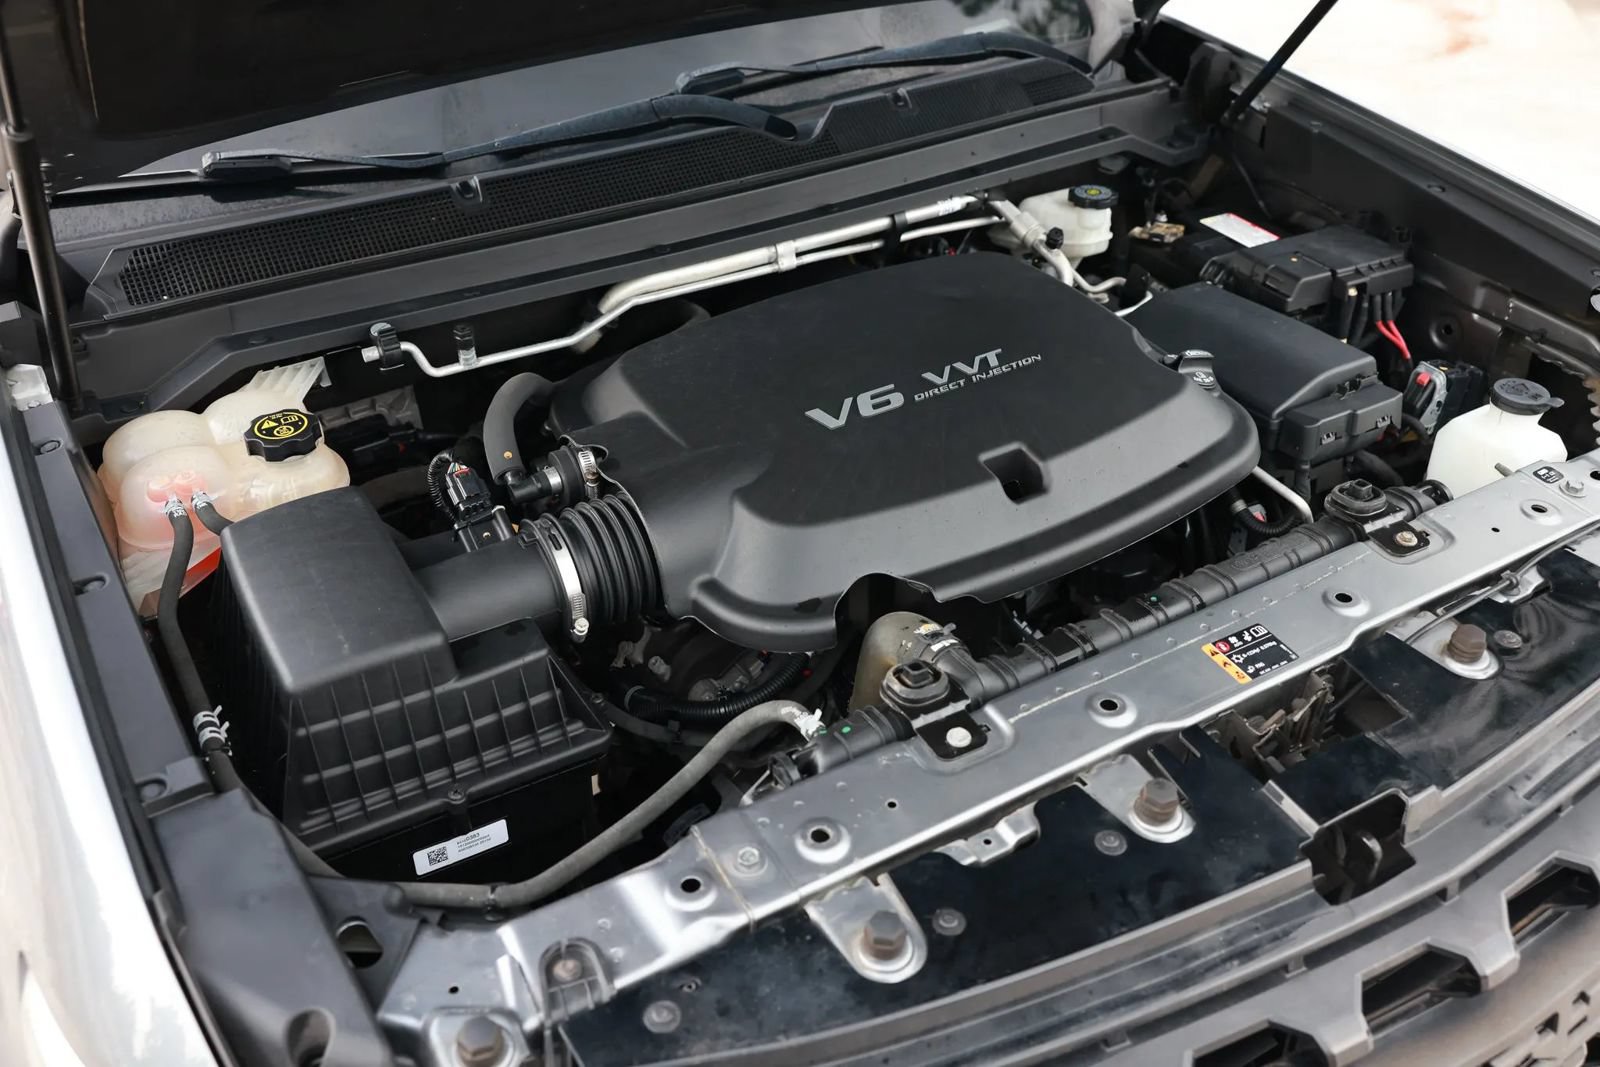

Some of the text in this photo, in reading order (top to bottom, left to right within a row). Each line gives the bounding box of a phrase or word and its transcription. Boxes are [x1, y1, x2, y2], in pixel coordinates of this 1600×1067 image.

[914, 353, 1042, 402] DIRECT INJECTION
[921, 348, 1002, 385] VVT
[805, 384, 904, 430] V6
